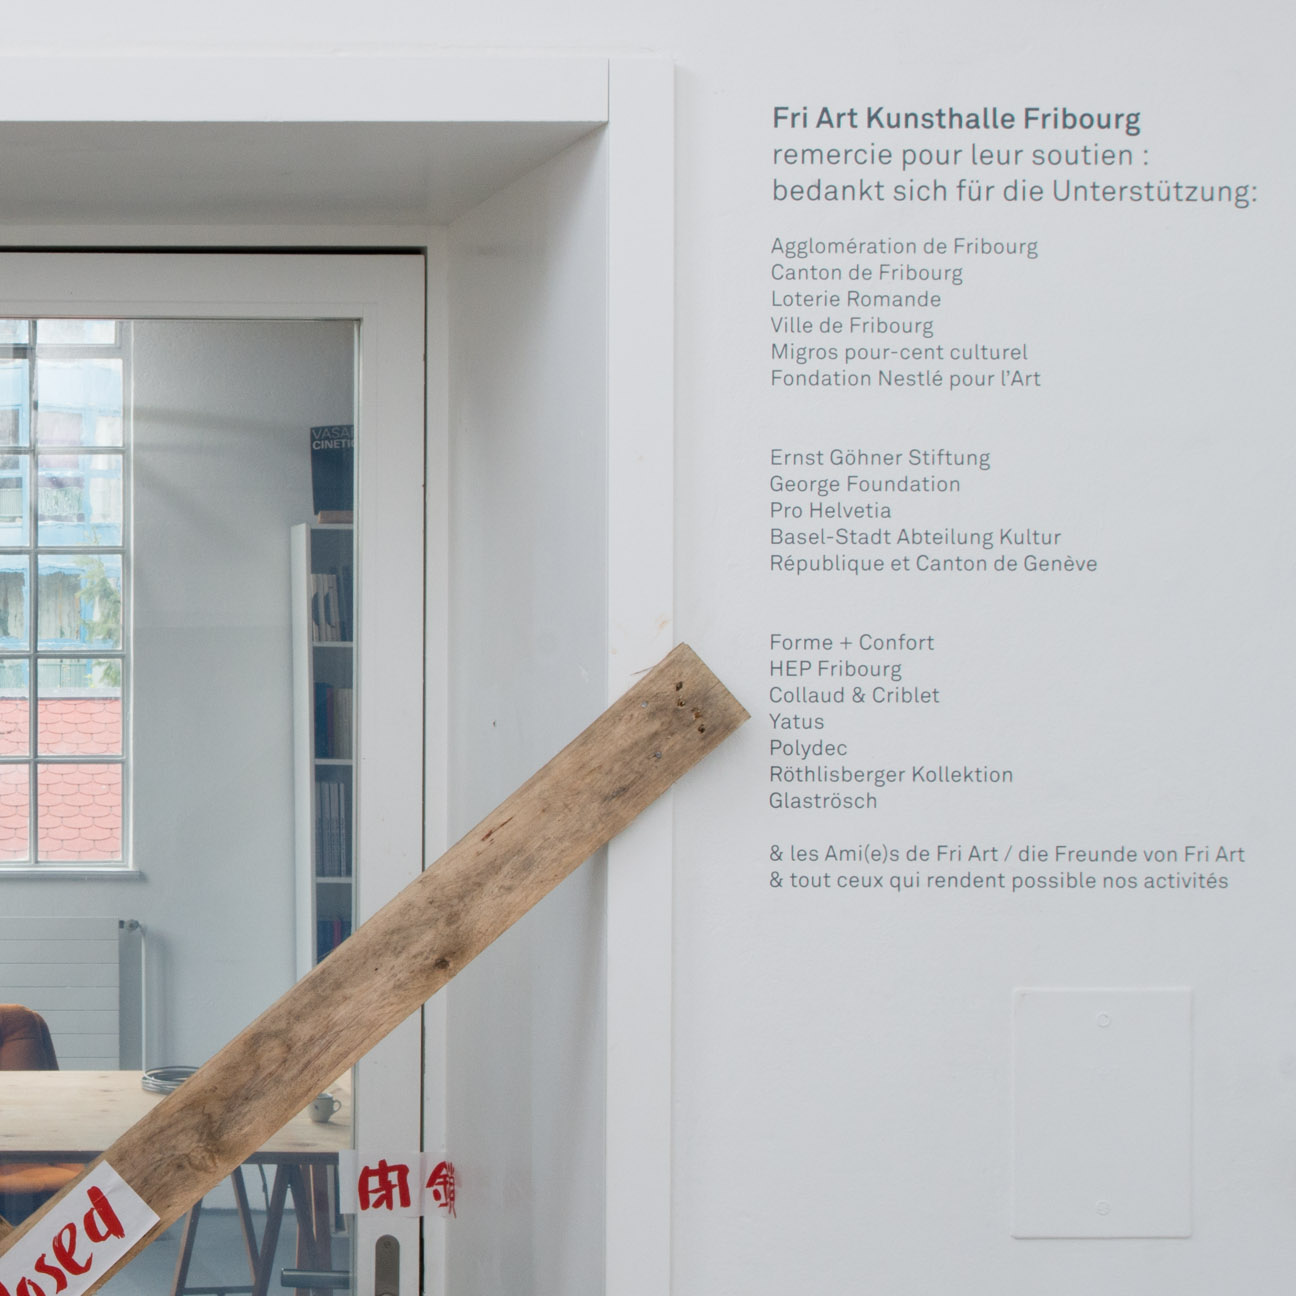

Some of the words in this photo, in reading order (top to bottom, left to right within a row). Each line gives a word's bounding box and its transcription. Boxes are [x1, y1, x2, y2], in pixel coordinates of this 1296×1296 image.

[774, 106, 808, 128] Fri
[815, 106, 858, 129] Art
[867, 106, 1015, 130] Kunsthalle
[1024, 107, 1141, 137] Fribourg
[774, 142, 892, 165] remercie
[902, 148, 963, 172] pour
[972, 143, 1024, 166] leur
[1032, 143, 1132, 166] soutien
[1144, 149, 1148, 166] :
[773, 178, 885, 201] bedankt
[893, 178, 947, 201] sich
[956, 179, 995, 202] für
[1003, 179, 1044, 202] die
[1053, 179, 1257, 209] Unterstützung:
[771, 237, 916, 259] Agglomération
[923, 237, 947, 254] de
[954, 237, 1038, 259] Fribourg
[771, 263, 842, 280] Canton
[848, 264, 872, 280] de
[880, 264, 963, 286] Fribourg
[772, 290, 840, 307] Loterie
[848, 290, 941, 307] Romande
[771, 316, 813, 333] Ville
[819, 317, 843, 333] de
[850, 316, 934, 338] Fribourg
[772, 343, 838, 365] Migros
[845, 345, 944, 365] pour-cent
[950, 344, 1028, 360] culturel
[772, 369, 871, 386] Fondation
[879, 370, 943, 386] Nestlé
[950, 374, 995, 391] pour
[771, 449, 824, 465] Ernst
[830, 449, 903, 466] Göhner
[909, 449, 991, 471] Stiftung
[770, 475, 840, 497] George
[847, 475, 960, 492] Foundation
[771, 502, 803, 518] Pro
[810, 501, 891, 518] Helvetia
[771, 528, 891, 545] Basel-Stadt
[896, 528, 994, 550] Abteilung
[1000, 528, 1062, 545] Kultur
[771, 554, 884, 576] République
[891, 556, 910, 571] et
[916, 554, 987, 571] Canton
[994, 554, 1018, 572] de
[1024, 555, 1097, 572] Genève
[771, 634, 833, 650] Forme
[840, 637, 853, 650] +
[859, 633, 935, 651] Confort
[770, 660, 812, 677] HEP
[818, 660, 902, 682] Fribourg
[770, 686, 844, 703] Collaud
[852, 687, 866, 703] &
[872, 686, 940, 703] Criblet
[769, 713, 824, 729] Yatus
[770, 739, 847, 760] Polydec
[770, 765, 906, 787] Röthlisberger
[912, 765, 1013, 783] Kollektion
[769, 792, 877, 809] Glaströsch
[770, 844, 783, 861] &
[791, 845, 819, 862] les
[824, 844, 899, 864] Ami(e)s
[906, 845, 930, 862] de
[937, 845, 961, 862] Fri
[968, 845, 999, 862] Art
[1004, 845, 1013, 862] /
[1018, 845, 1048, 862] die
[1056, 845, 1137, 862] Freunde
[1143, 850, 1178, 862] von
[1185, 846, 1209, 862] Fri
[1215, 846, 1245, 862] Art
[770, 871, 783, 888] &
[789, 872, 831, 888] tout
[837, 876, 883, 888] ceux
[890, 871, 920, 892] qui
[927, 871, 1005, 888] rendent
[1012, 872, 1096, 893] possible
[1103, 876, 1138, 889] nos
[1144, 872, 1228, 889] activités
